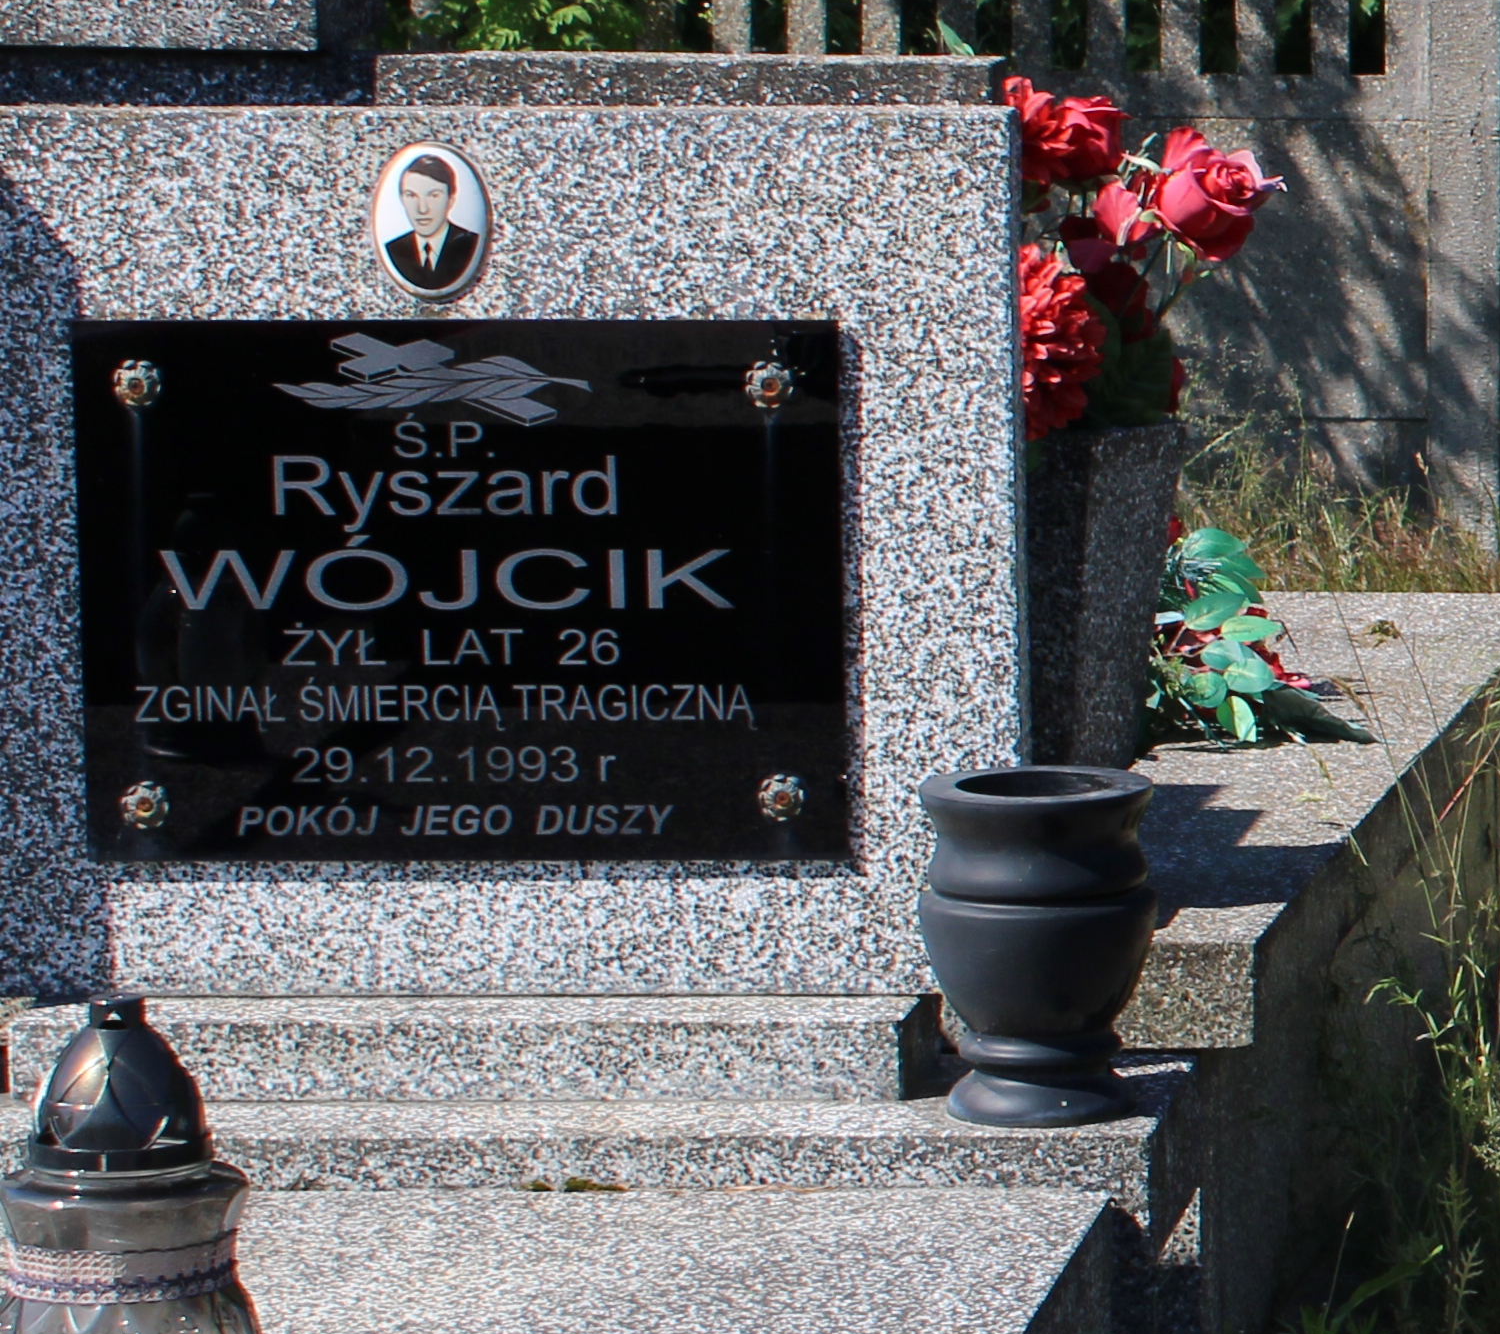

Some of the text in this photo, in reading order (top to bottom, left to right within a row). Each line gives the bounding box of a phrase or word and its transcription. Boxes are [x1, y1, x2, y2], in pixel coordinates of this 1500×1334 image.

[395, 413, 494, 458] Ś.P.
[272, 454, 618, 532] Ryszard
[160, 534, 734, 610] WÓJCIK
[282, 621, 620, 666] ŻYŁ LAT 26
[134, 678, 757, 731] ZGINAŁ ŚMIERCIĄ TRAGICZNĄ
[292, 747, 615, 783] 29.12.1993 r
[237, 798, 674, 837] POKÓJ JEGO DUSZY
